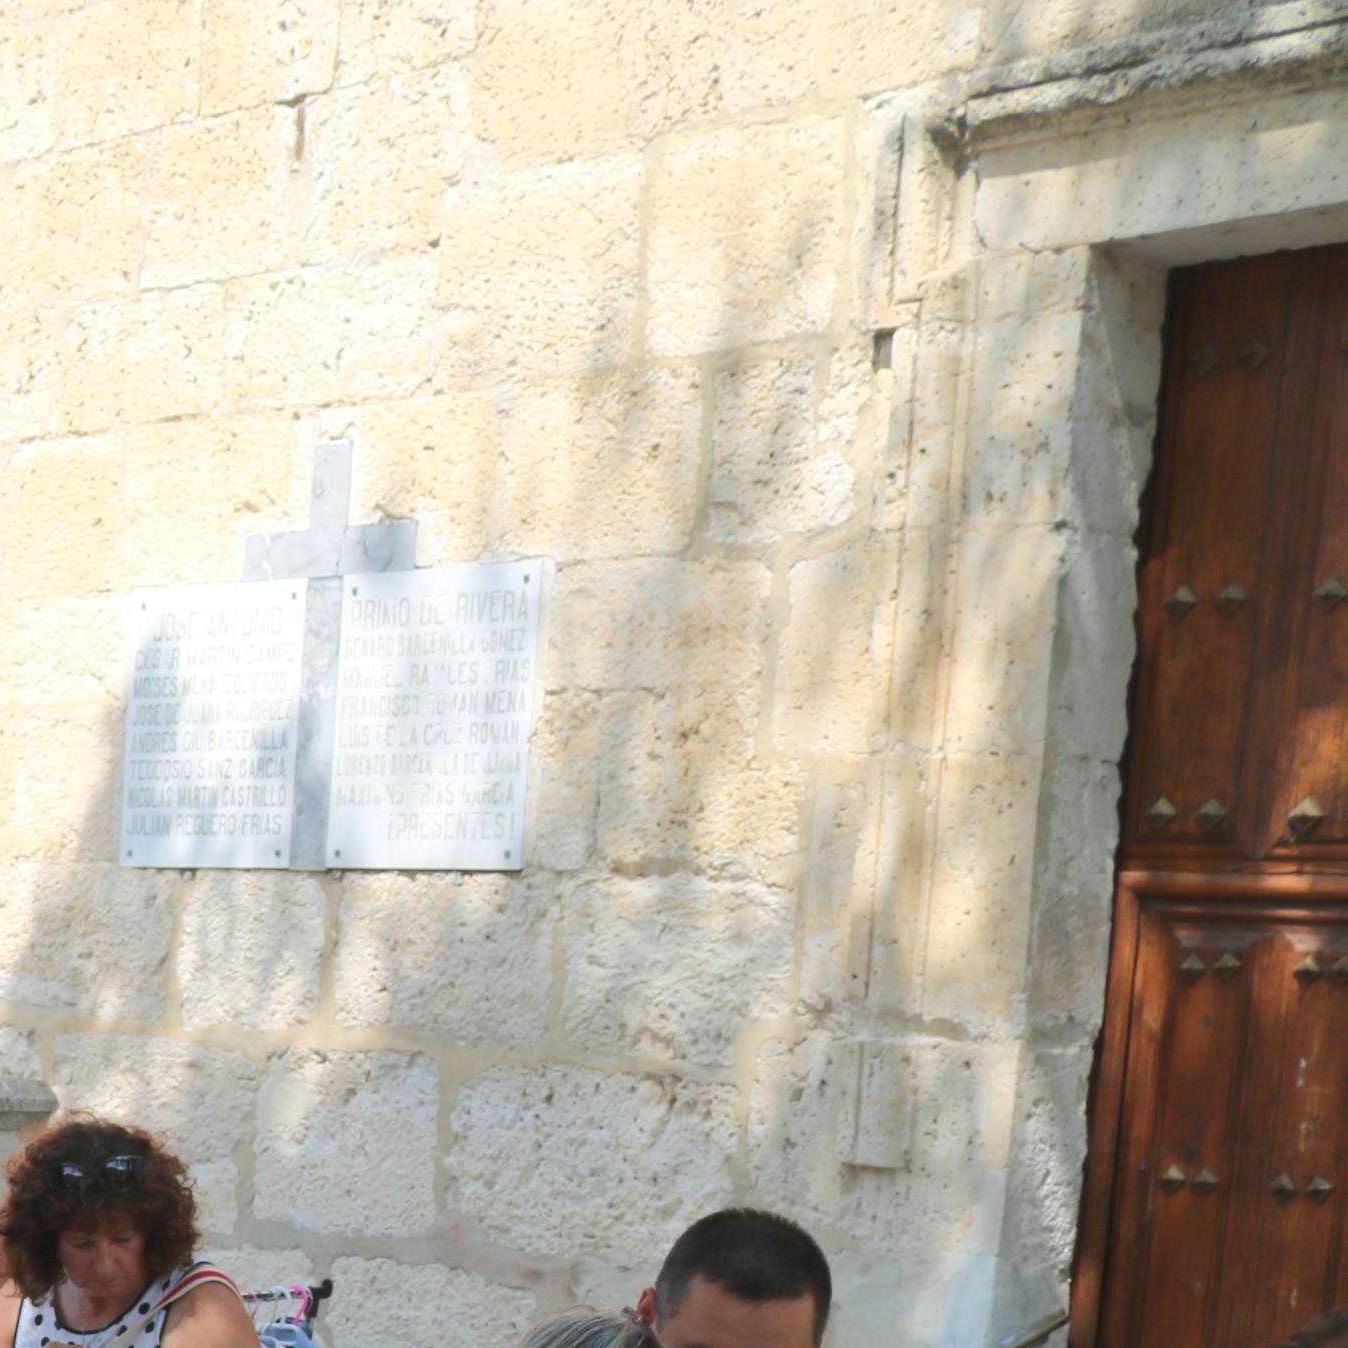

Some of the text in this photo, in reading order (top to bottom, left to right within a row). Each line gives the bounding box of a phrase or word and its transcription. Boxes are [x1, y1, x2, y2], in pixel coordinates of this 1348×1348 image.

[350, 590, 529, 630] PRIMO DE RIVERA
[153, 607, 282, 642] JOSE ANTONIO
[345, 628, 525, 659] GENARO BARCENILLA GOMEZ
[135, 642, 295, 671] CESAR MARTIN CAMPO
[133, 676, 178, 698] MOISES
[182, 673, 215, 697] MENA
[132, 704, 161, 726] JOSE
[165, 703, 180, 724] DE
[184, 702, 221, 724] JUANA
[340, 694, 420, 720] FRANCISCO
[485, 690, 525, 714] MENA
[131, 729, 287, 753] ANDRES GIL BARCENILLA
[339, 724, 370, 749] LUIS
[377, 724, 395, 746] DE
[469, 721, 519, 745] ROMAN
[131, 760, 193, 781] TEODOSIO
[197, 759, 232, 779] SANZ
[463, 752, 477, 773] DE
[128, 785, 285, 808] NICOLAS MARTIN CASTRILLO
[127, 813, 281, 836] JULIAN REGUERO FRIAS
